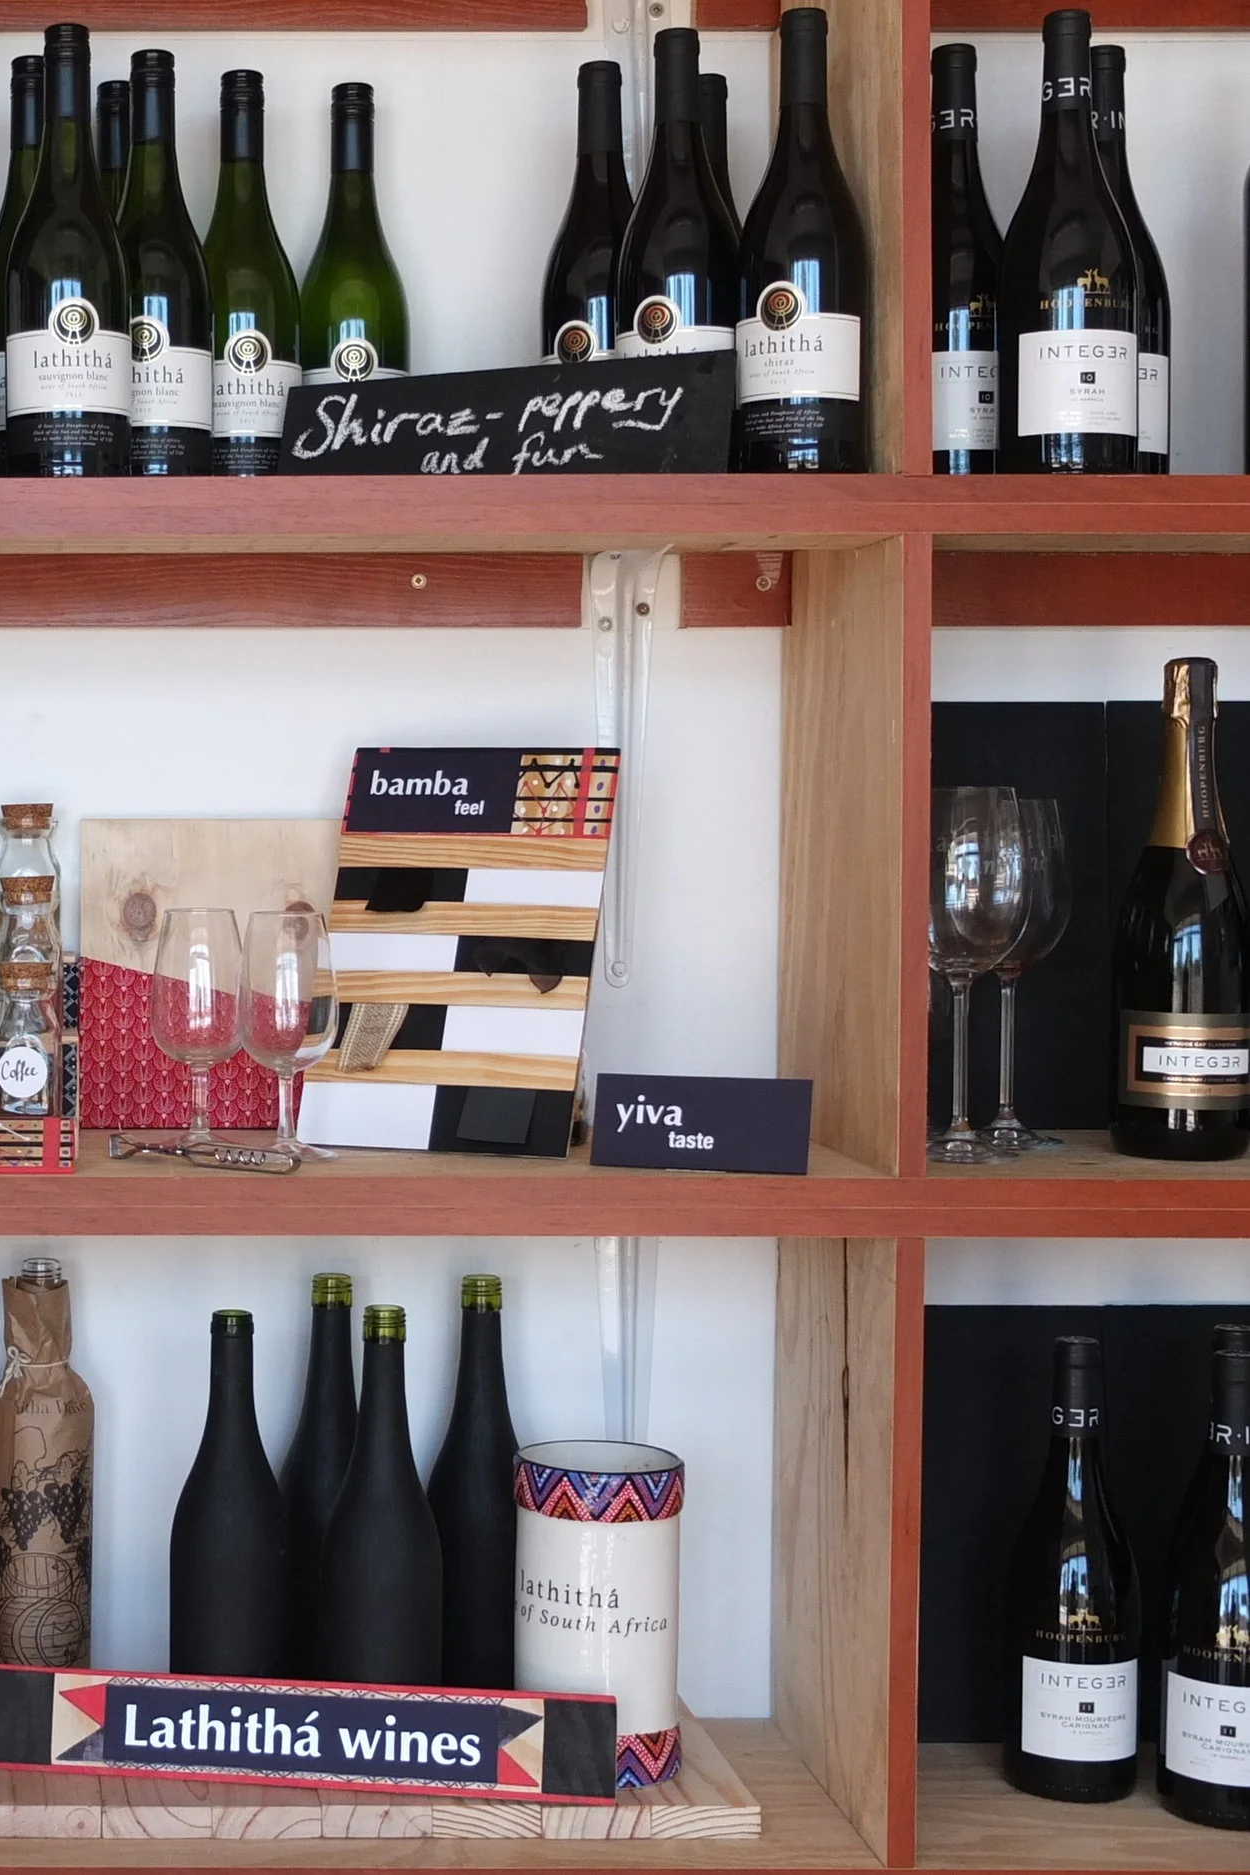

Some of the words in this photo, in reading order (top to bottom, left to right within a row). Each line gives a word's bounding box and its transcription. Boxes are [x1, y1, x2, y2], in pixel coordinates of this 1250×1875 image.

[745, 333, 823, 358] lathithá
[32, 349, 112, 369] lathithá
[764, 357, 794, 368] shiraz
[38, 371, 84, 383] sauvignon
[86, 370, 108, 382] blanc
[214, 377, 285, 397] athithá
[155, 386, 180, 397] blanc
[1070, 388, 1105, 396] SYRAH
[259, 399, 282, 410] blanc
[517, 386, 684, 432] peppery
[420, 437, 485, 474] and
[370, 770, 469, 796] bamba
[454, 799, 485, 816] feel
[1, 1059, 38, 1081] Coffee
[616, 1095, 683, 1132] yiva
[668, 1130, 714, 1151] taste
[520, 1569, 619, 1609] lathithá
[520, 1604, 535, 1622] of
[539, 1609, 596, 1632] South
[608, 1616, 668, 1638] Africa
[124, 1703, 321, 1758] Lathithá
[339, 1714, 482, 1768] wines
[1061, 1721, 1110, 1730] CARIGNAN
